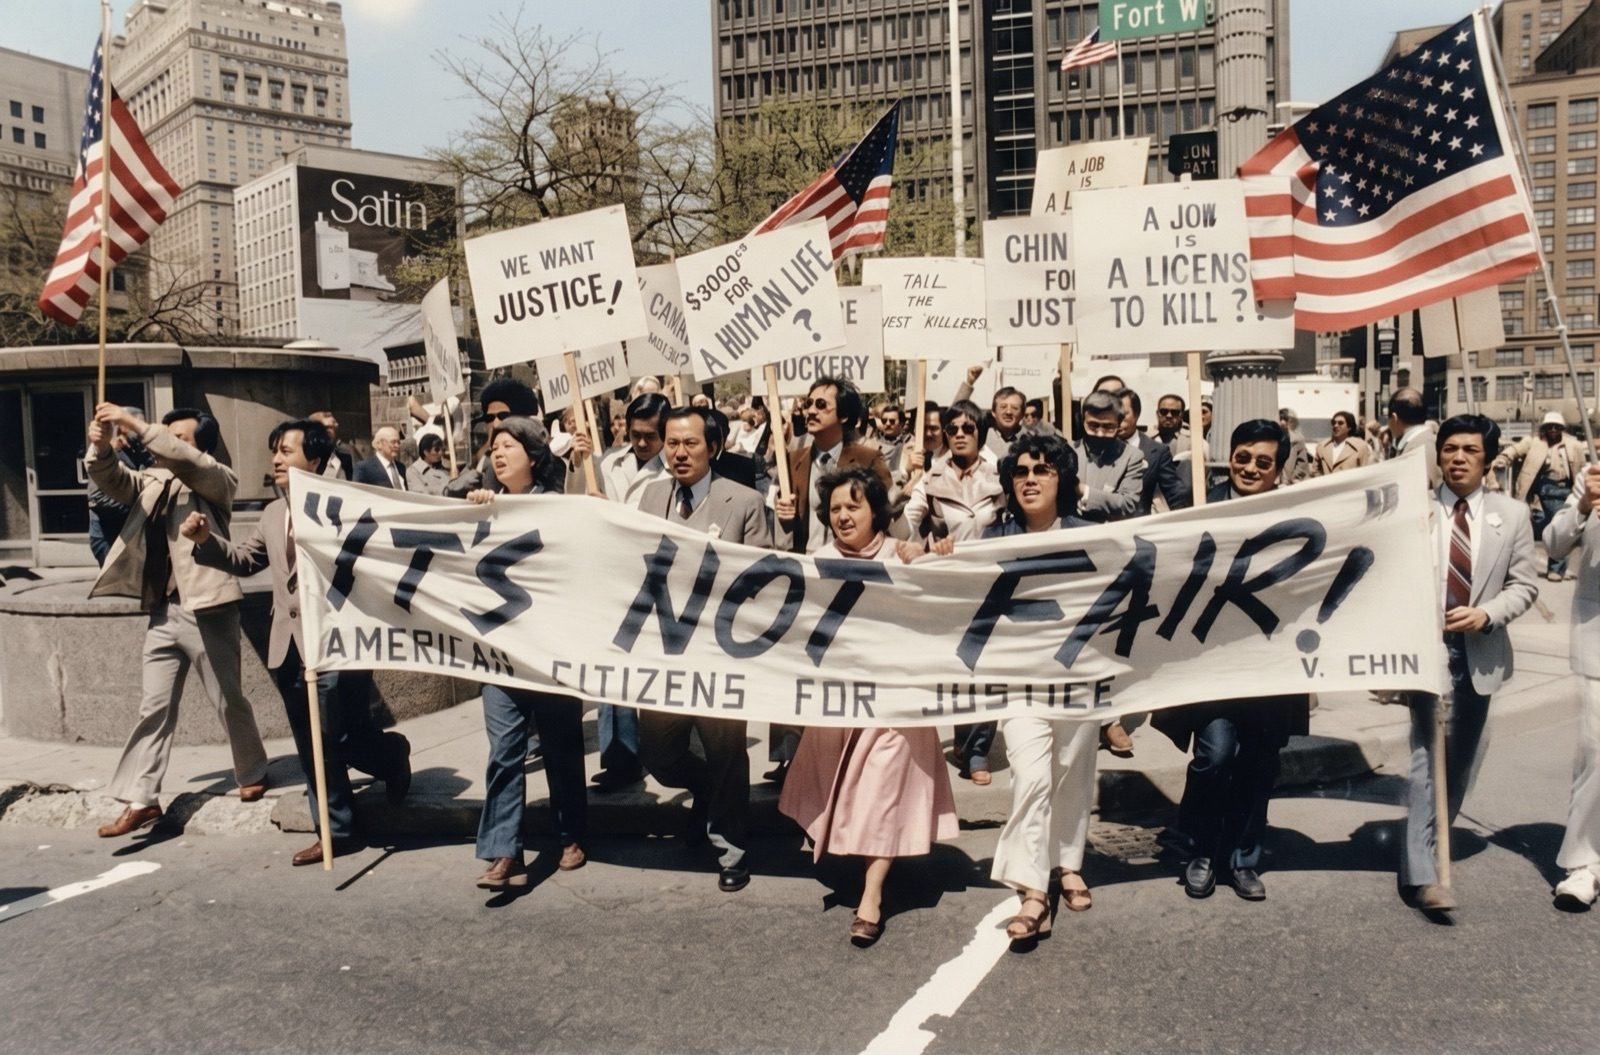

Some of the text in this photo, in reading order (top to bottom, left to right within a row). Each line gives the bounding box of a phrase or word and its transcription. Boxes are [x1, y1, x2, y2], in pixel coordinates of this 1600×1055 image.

[1113, 0, 1198, 30] Fort W
[1067, 156, 1105, 176] A JOB
[1080, 176, 1092, 188] IS
[330, 178, 427, 231] Satin
[1045, 192, 1056, 213] A
[1143, 206, 1159, 231] A
[1005, 232, 1068, 263] CHIN
[1176, 234, 1196, 248] IS
[500, 240, 595, 279] WE WANT
[1107, 252, 1248, 289] A LICENS
[723, 275, 753, 306] FOR
[1045, 269, 1076, 291] FO
[494, 273, 623, 325] JUSTICE!
[699, 239, 833, 376] A HUMAN LIFE
[908, 296, 934, 307] THE
[1110, 295, 1144, 329] TO
[1163, 291, 1217, 326] KILL
[792, 308, 822, 342] ?
[549, 355, 615, 400] MOKERY
[613, 533, 894, 667] NOT
[326, 626, 1117, 718] AMERICAN CITIZENS FOR JUSTICE
[1300, 653, 1420, 679] V. CHIN
